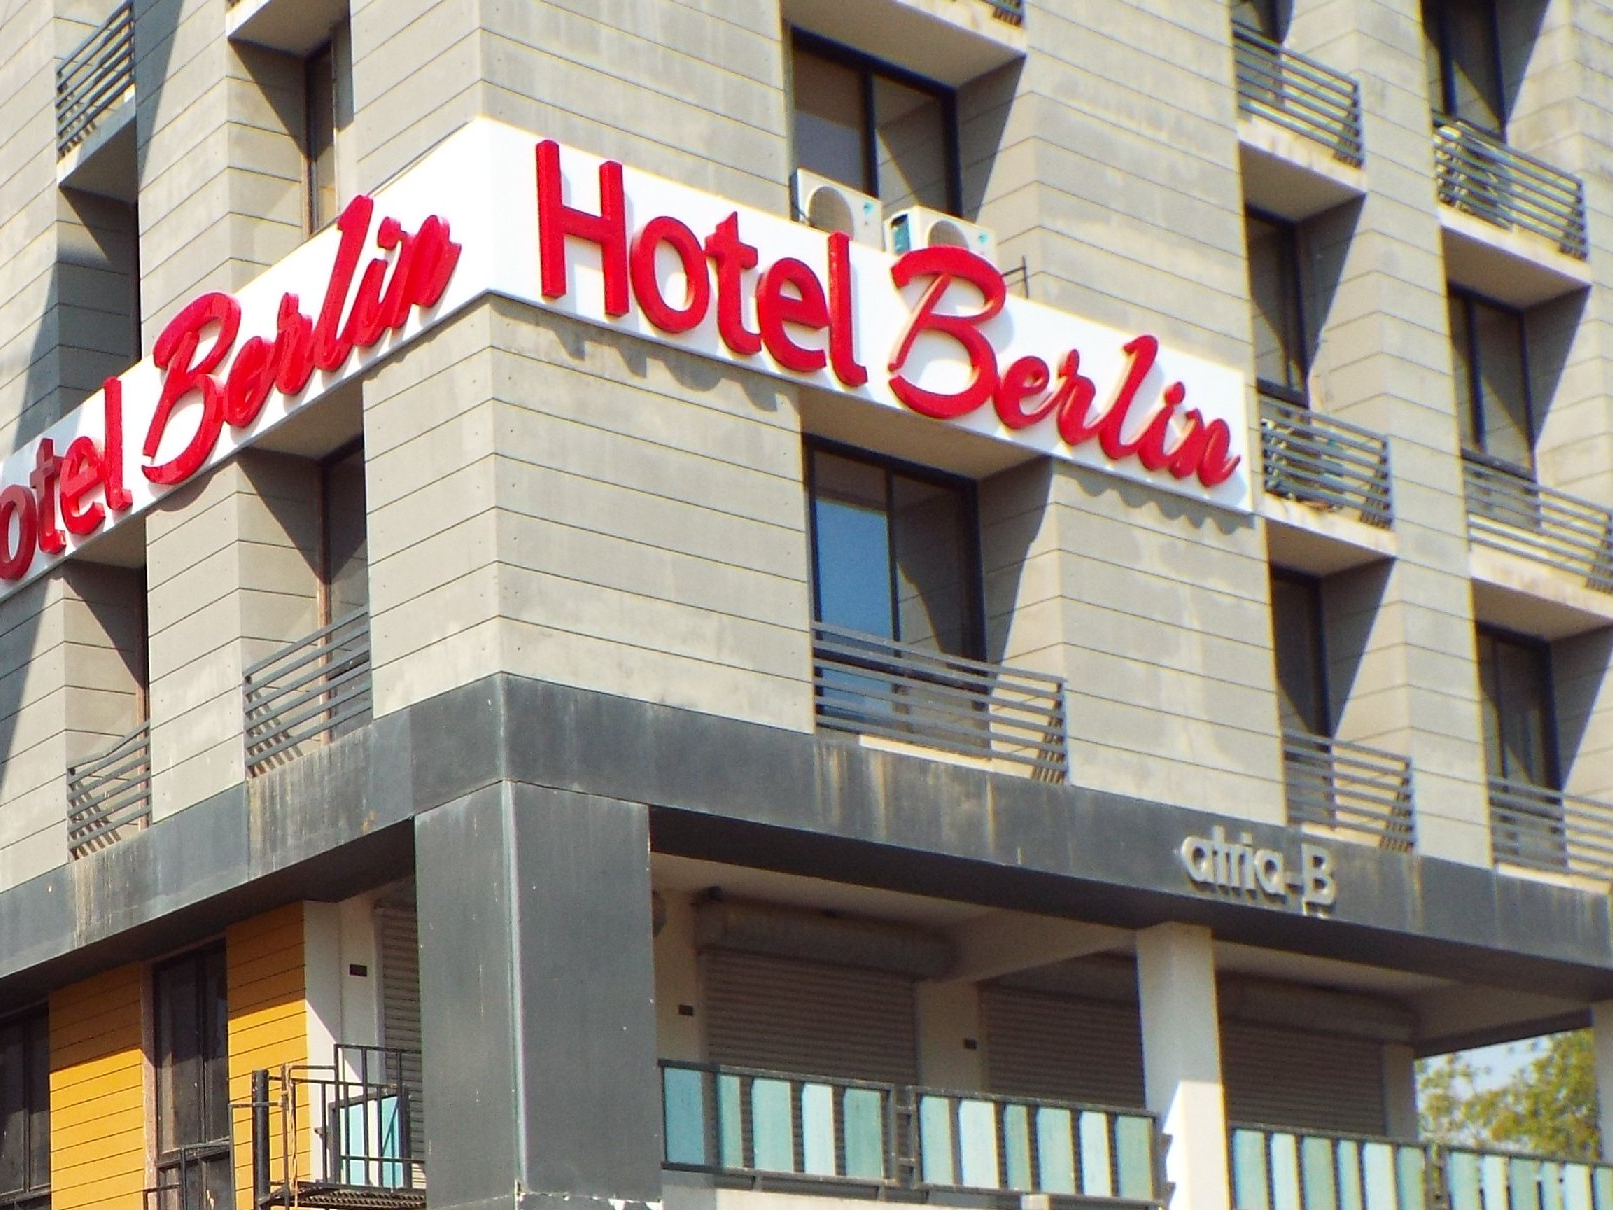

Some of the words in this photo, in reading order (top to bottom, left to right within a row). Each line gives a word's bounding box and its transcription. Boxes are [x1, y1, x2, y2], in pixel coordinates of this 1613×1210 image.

[141, 194, 463, 486] Berlin
[535, 139, 868, 388] Hotel
[887, 245, 1242, 488] Berlin
